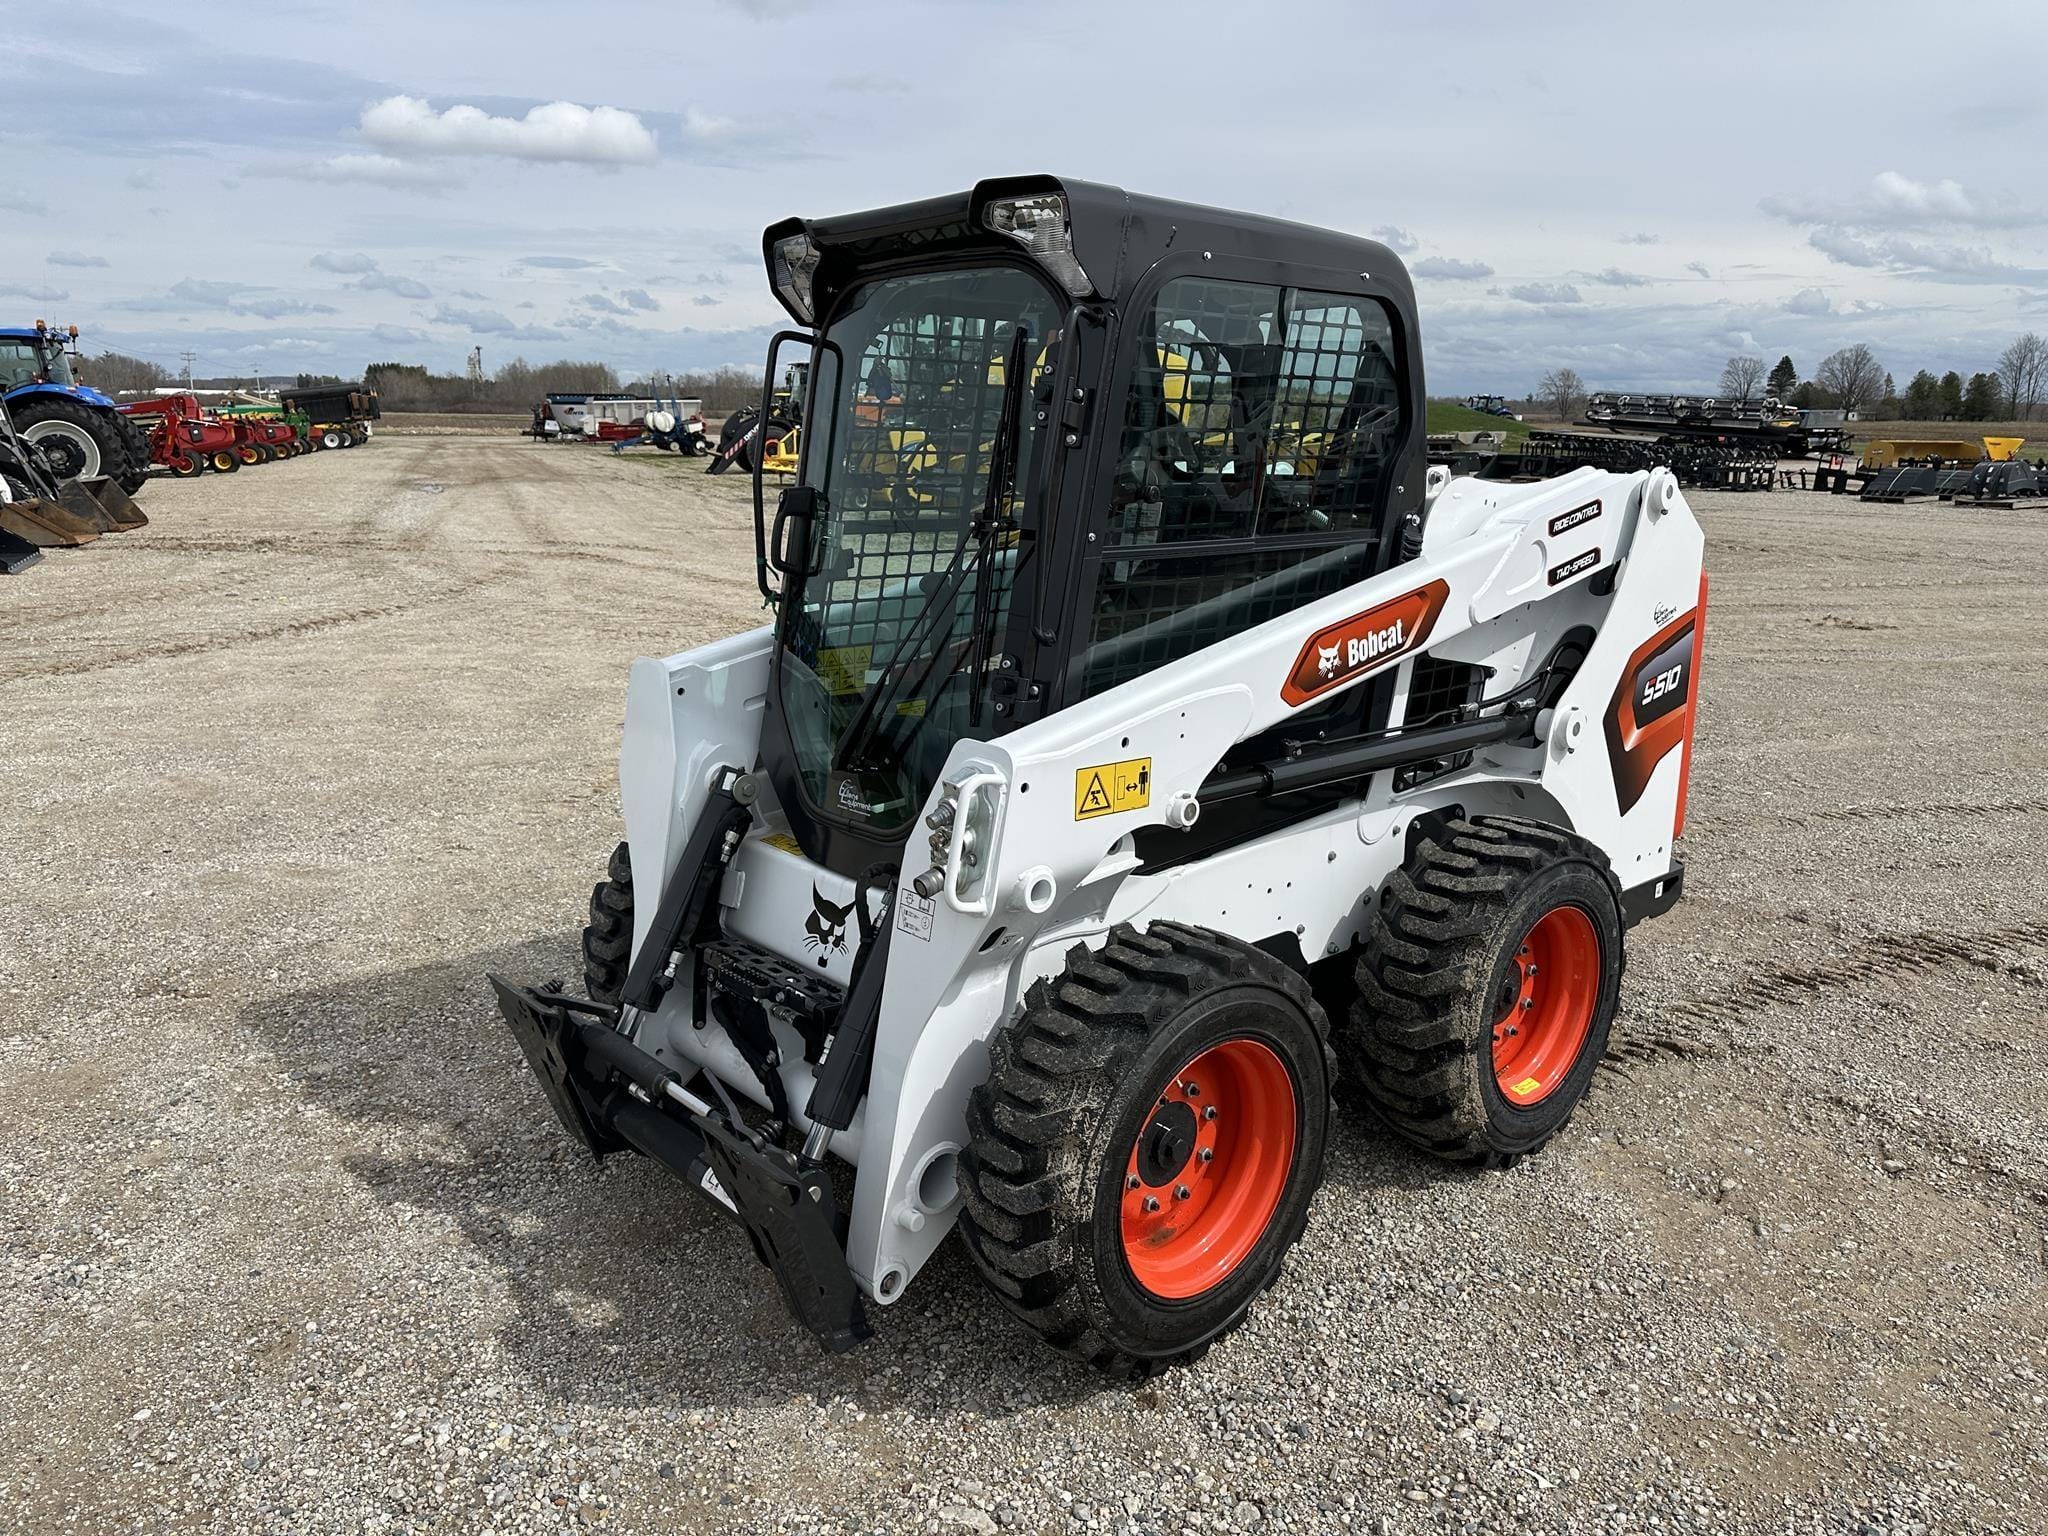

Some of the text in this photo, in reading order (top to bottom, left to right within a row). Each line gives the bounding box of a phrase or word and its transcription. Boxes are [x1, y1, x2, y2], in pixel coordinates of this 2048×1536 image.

[1552, 503, 1600, 533] RIDE CONTROL
[1556, 552, 1596, 580] TWO-SPEED
[1347, 618, 1403, 668] Bobcat
[1641, 664, 1682, 706] S510
